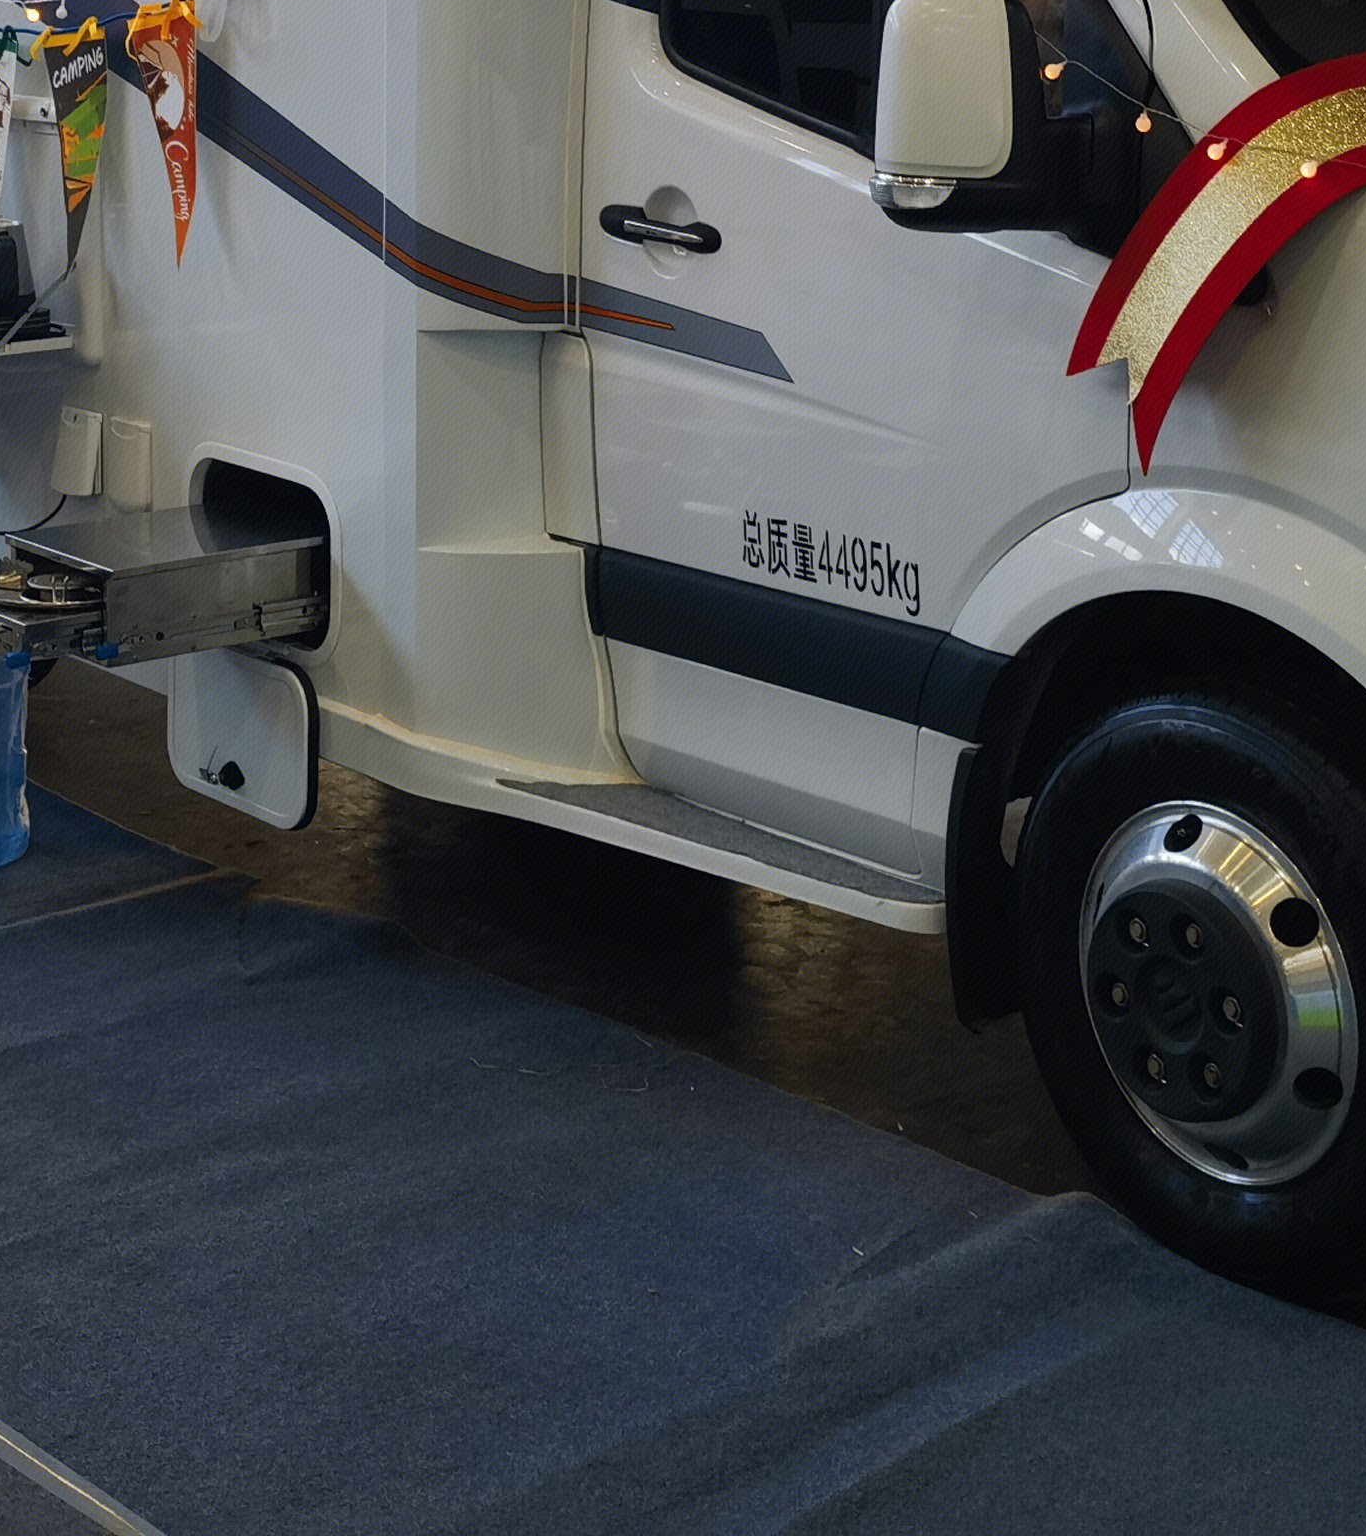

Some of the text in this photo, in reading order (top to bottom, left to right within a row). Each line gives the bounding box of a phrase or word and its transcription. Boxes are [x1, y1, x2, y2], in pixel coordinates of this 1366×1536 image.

[52, 46, 104, 89] CAMPING
[164, 140, 190, 222] Camping
[742, 509, 921, 617] 总质量4495kg
